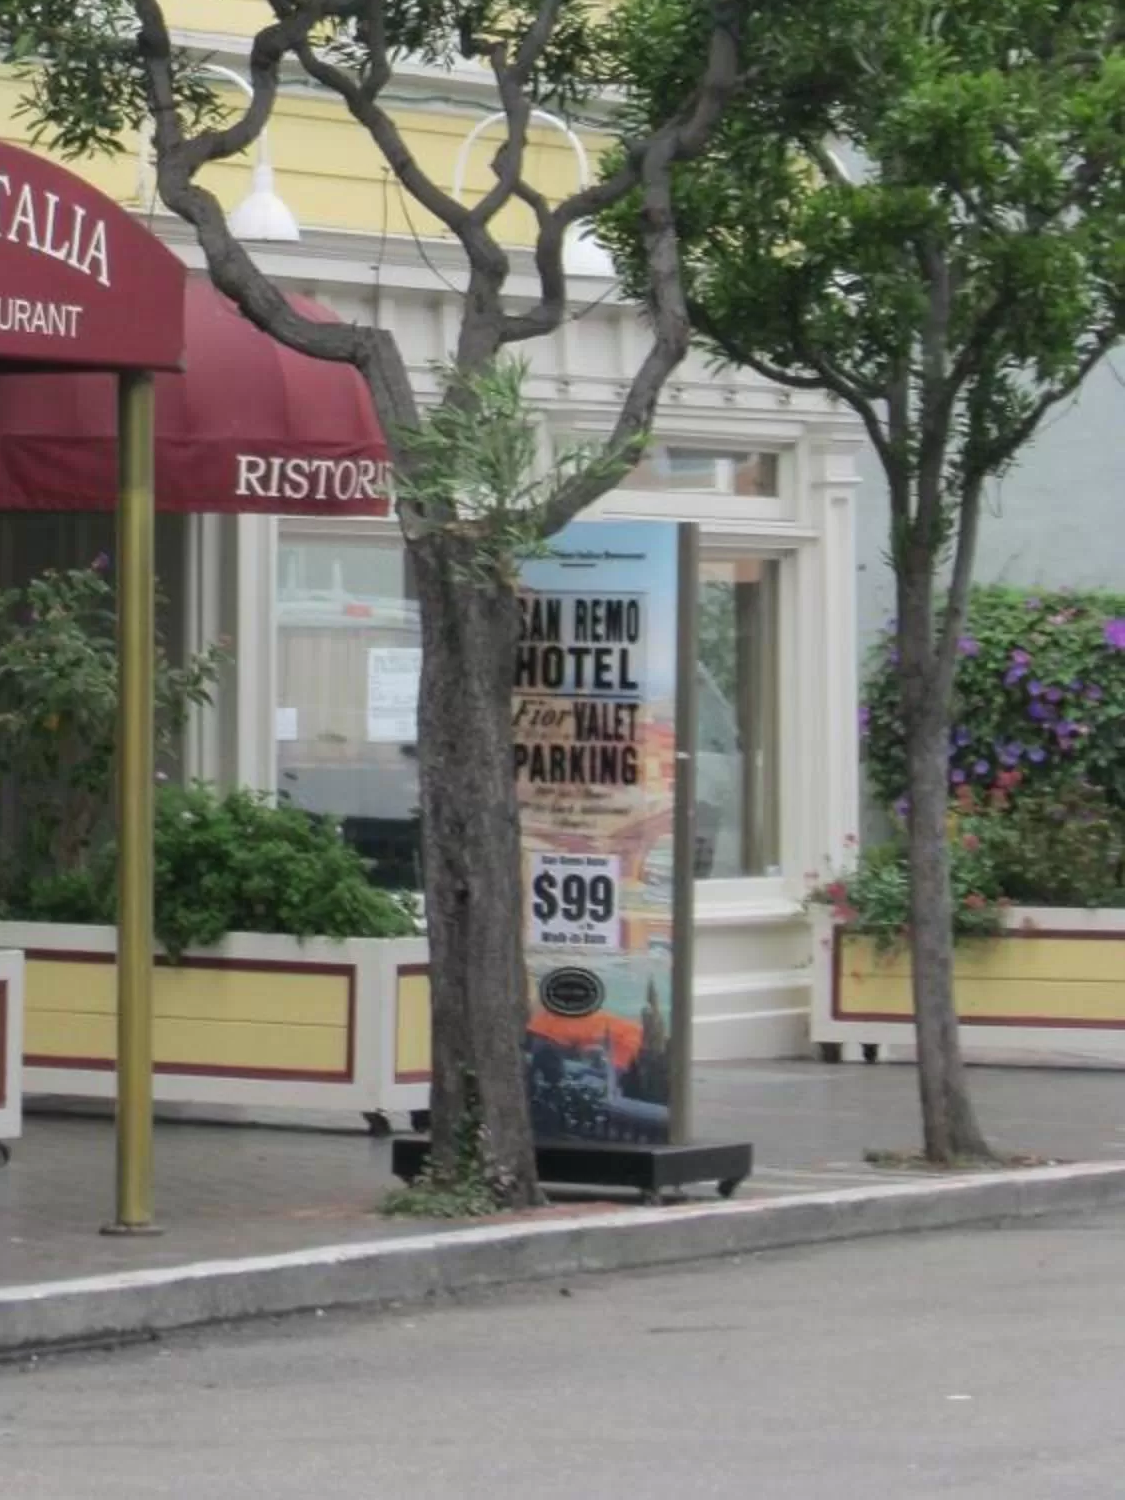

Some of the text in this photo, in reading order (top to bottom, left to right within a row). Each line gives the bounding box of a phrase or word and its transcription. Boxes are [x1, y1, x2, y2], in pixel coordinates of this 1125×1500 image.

[517, 598, 640, 643] SAN REMO
[515, 645, 639, 690] HOTEL
[574, 701, 639, 741] VALET
[513, 743, 638, 785] PARKING
[533, 869, 614, 925] $99
